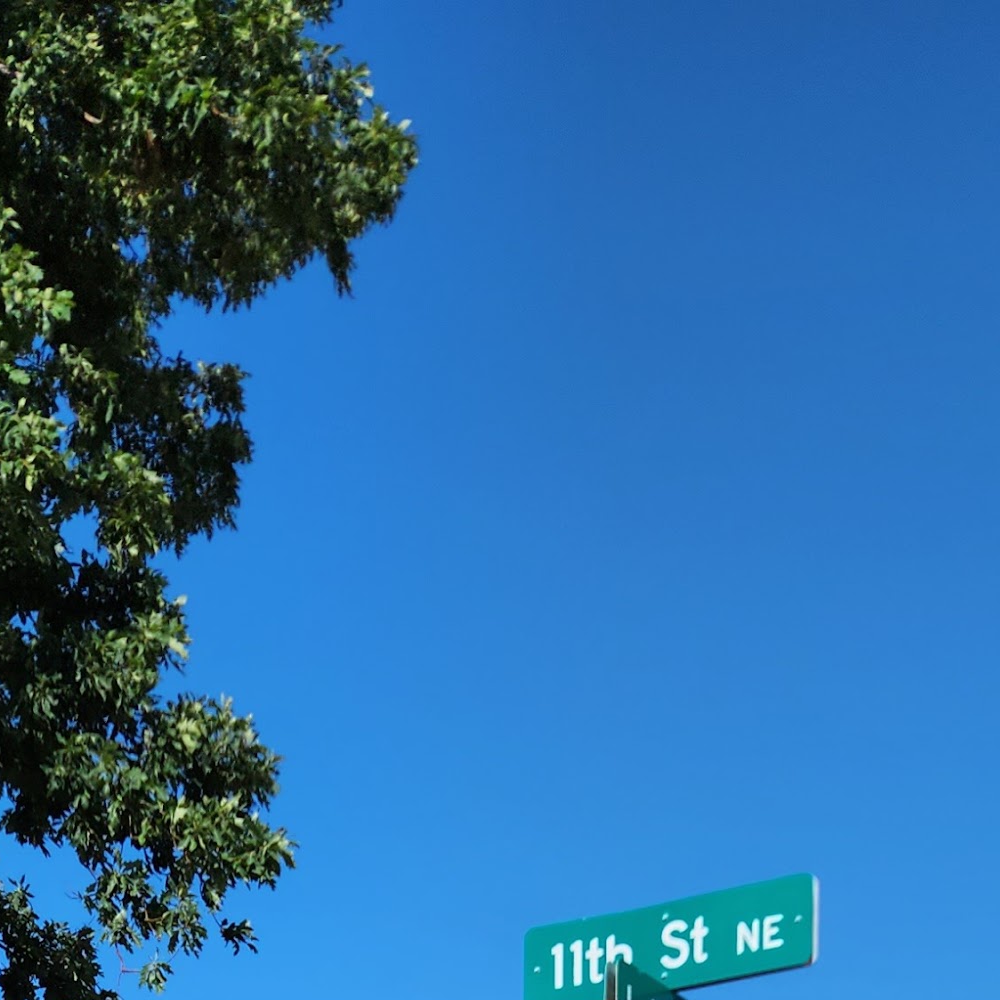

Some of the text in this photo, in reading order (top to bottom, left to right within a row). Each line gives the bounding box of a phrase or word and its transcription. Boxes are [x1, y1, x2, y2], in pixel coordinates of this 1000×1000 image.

[550, 913, 785, 990] 11th St NE
